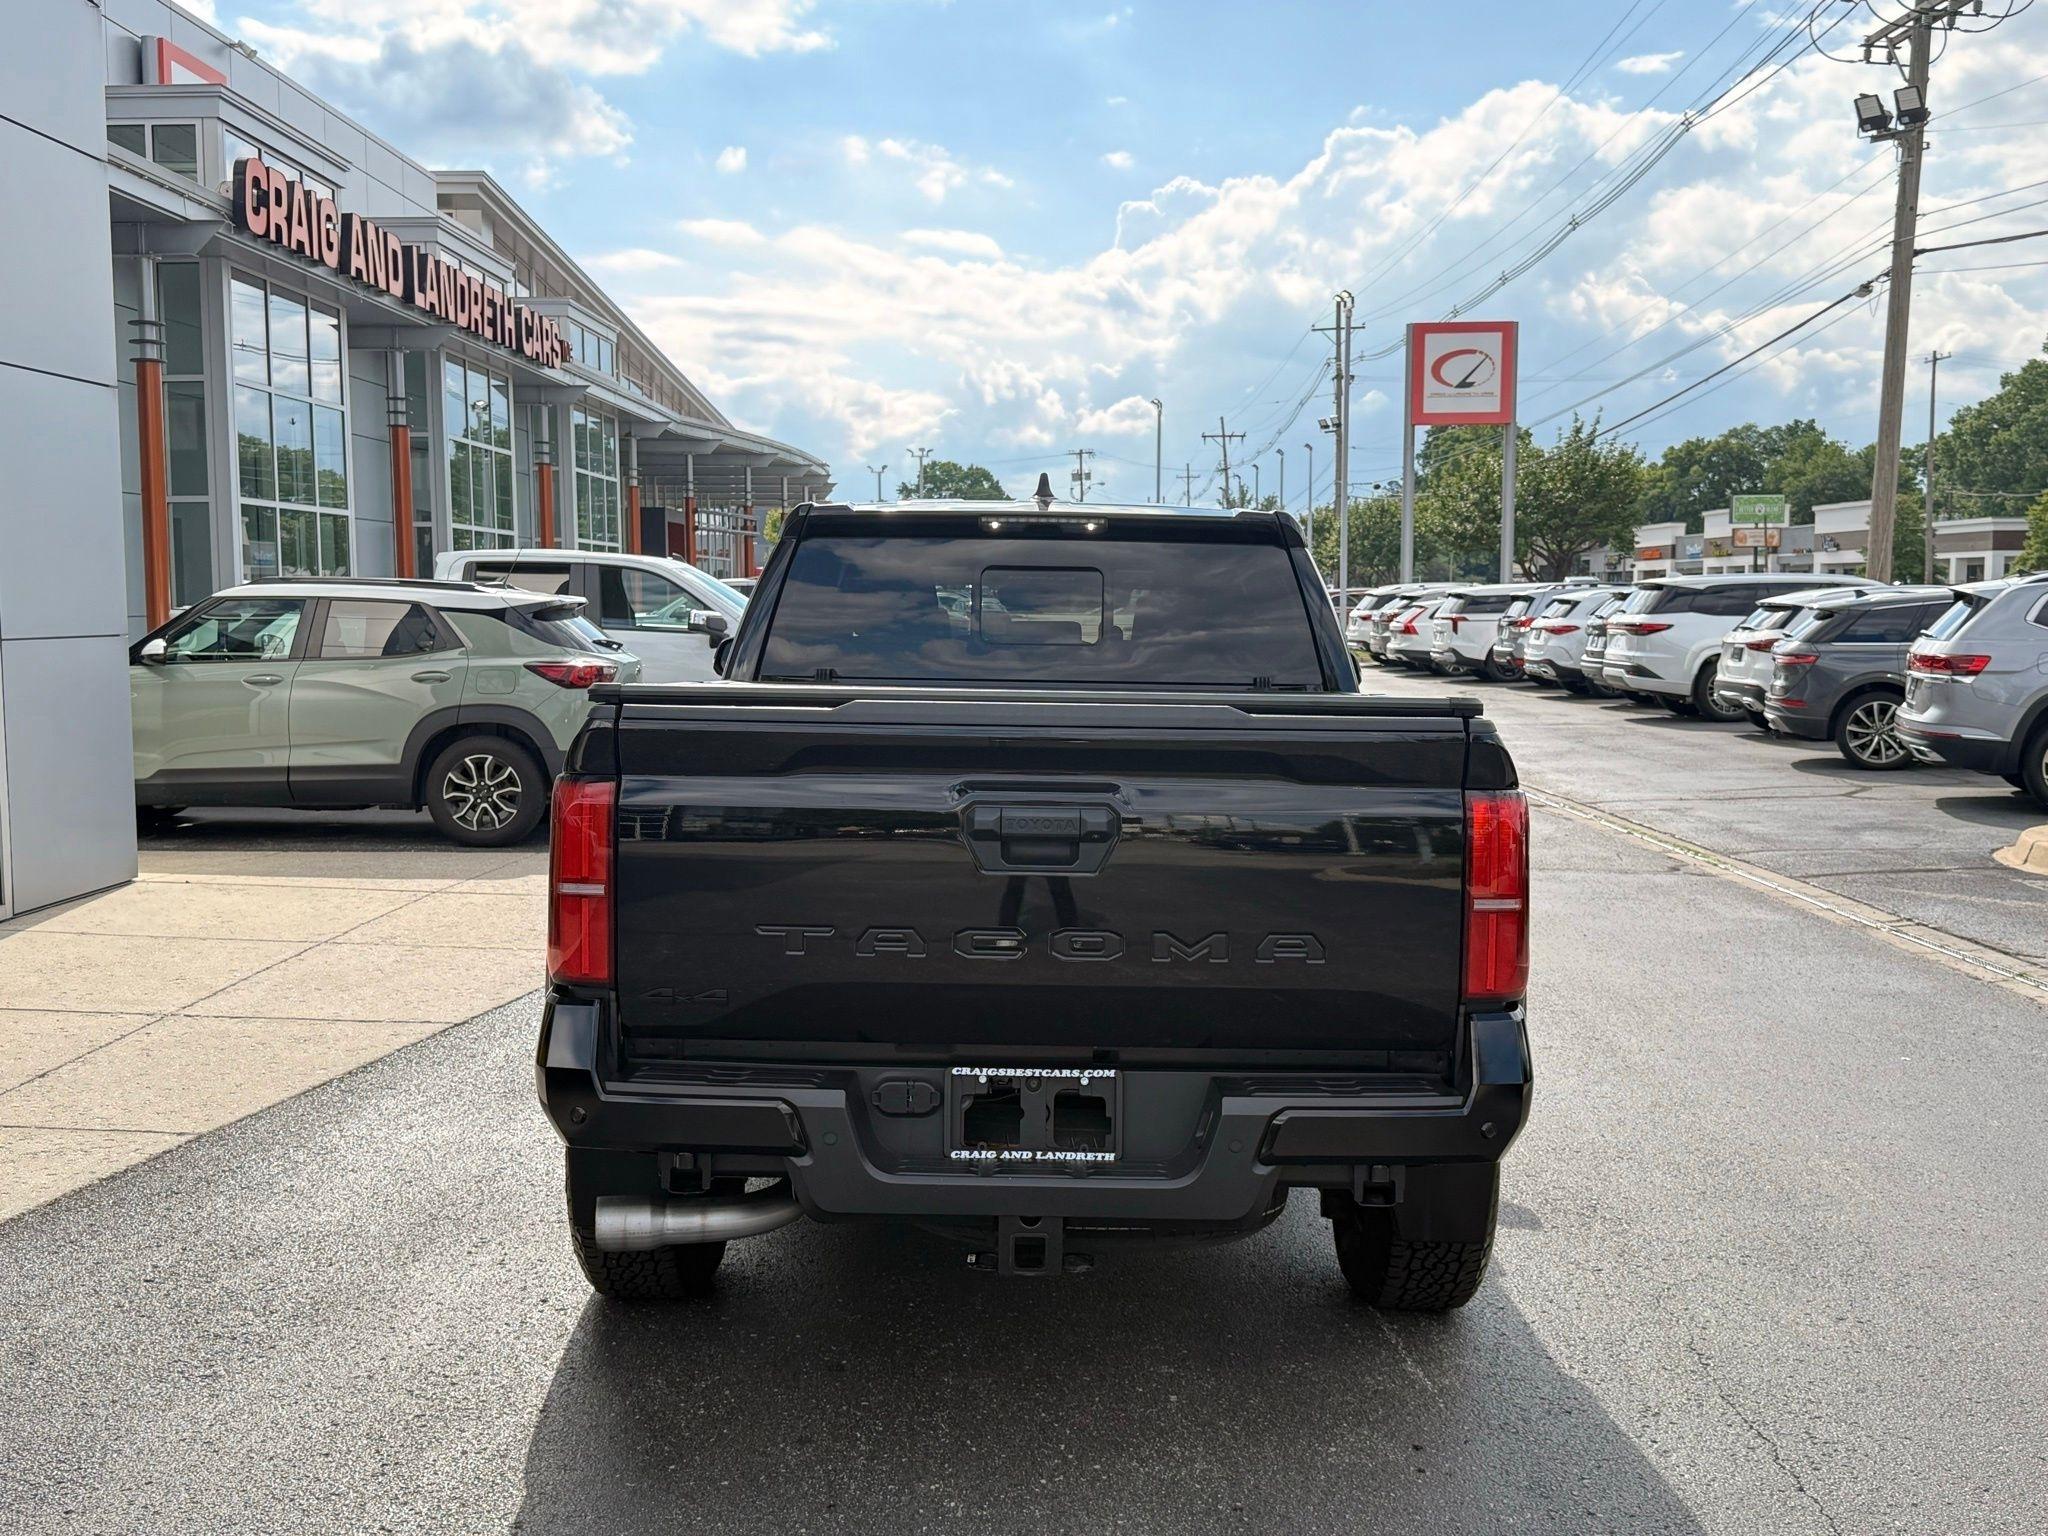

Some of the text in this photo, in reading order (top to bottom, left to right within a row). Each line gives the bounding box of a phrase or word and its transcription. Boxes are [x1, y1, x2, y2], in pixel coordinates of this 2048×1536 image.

[241, 157, 340, 269] CRAIG
[346, 212, 404, 299] AND
[409, 244, 517, 351] LANDRETH
[519, 304, 562, 370] CARS
[1006, 817, 1078, 832] TOYOTA
[753, 923, 1329, 965] TACOMA
[951, 1066, 1117, 1078] CRAIGSBESTCARS.COM
[950, 1149, 1116, 1162] CRAIG AND LANDRETH
